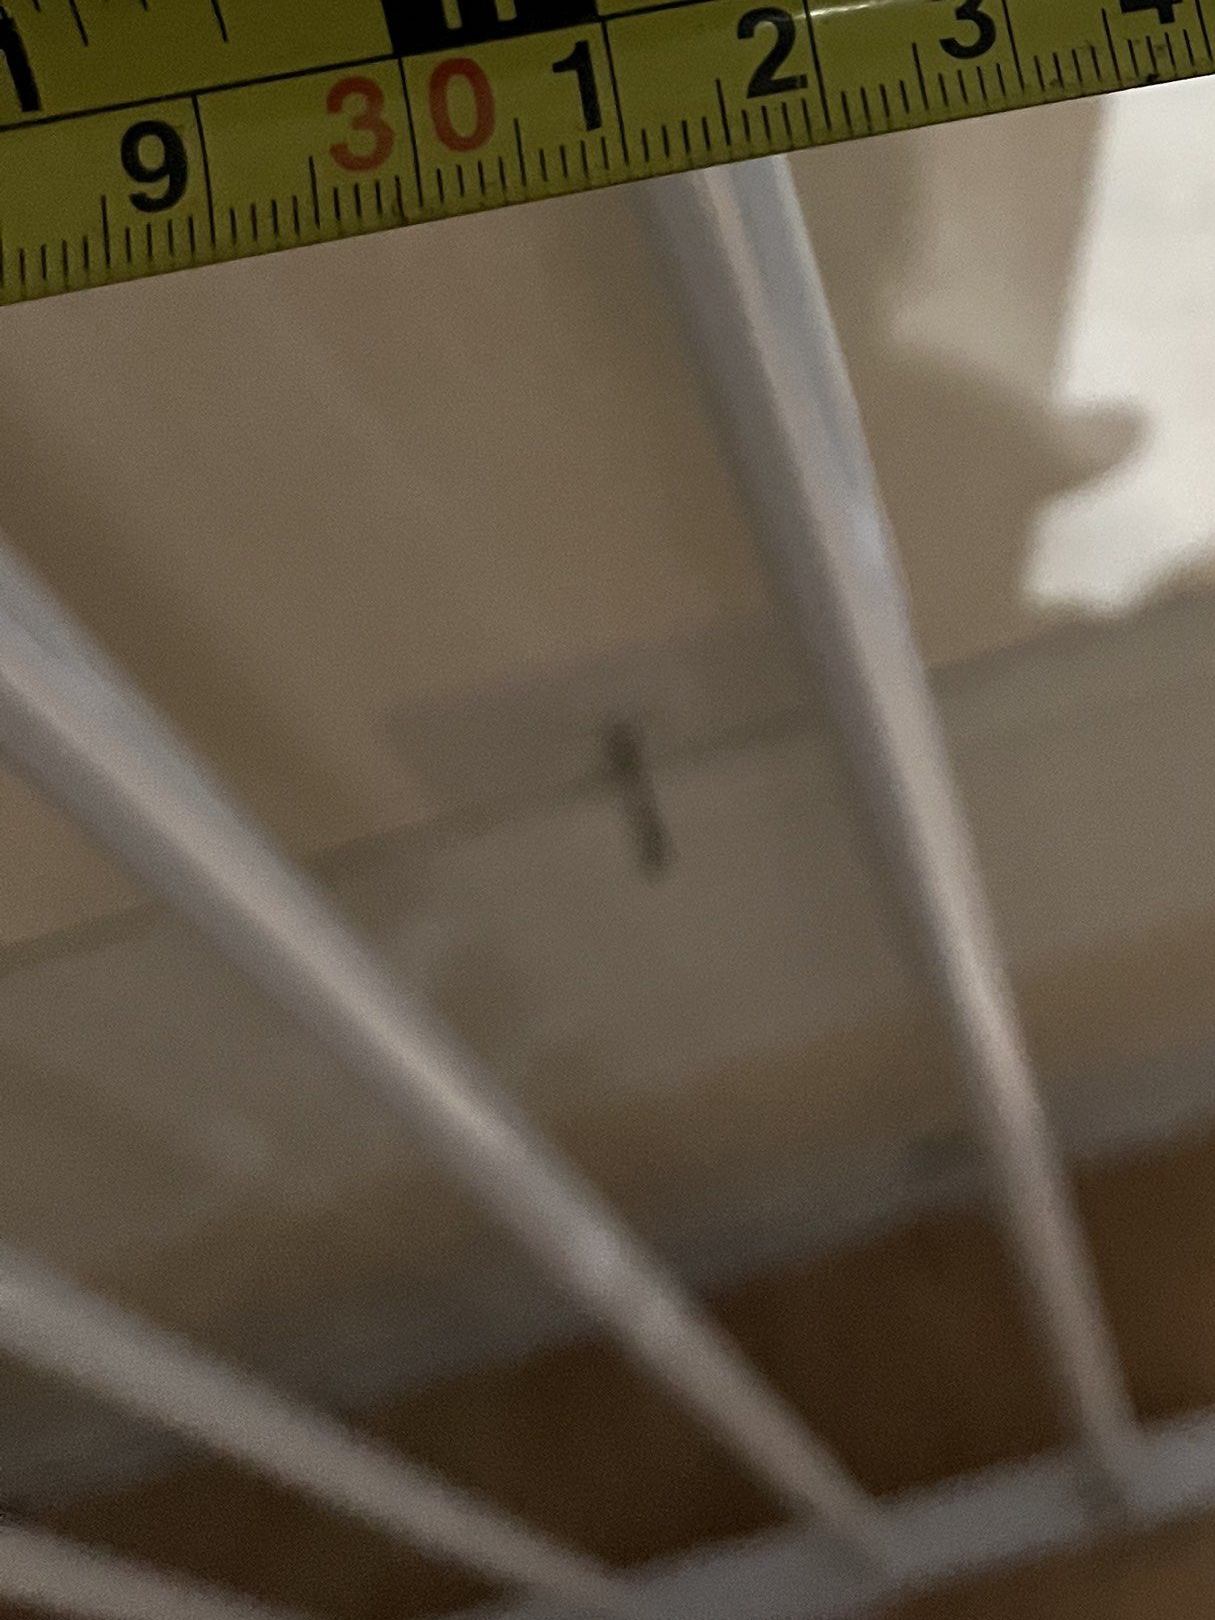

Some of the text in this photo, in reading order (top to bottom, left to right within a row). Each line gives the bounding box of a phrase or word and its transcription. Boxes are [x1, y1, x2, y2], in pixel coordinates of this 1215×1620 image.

[551, 40, 602, 132] 1
[736, 6, 808, 99] 2
[325, 57, 497, 173] 30
[119, 119, 189, 214] 9
